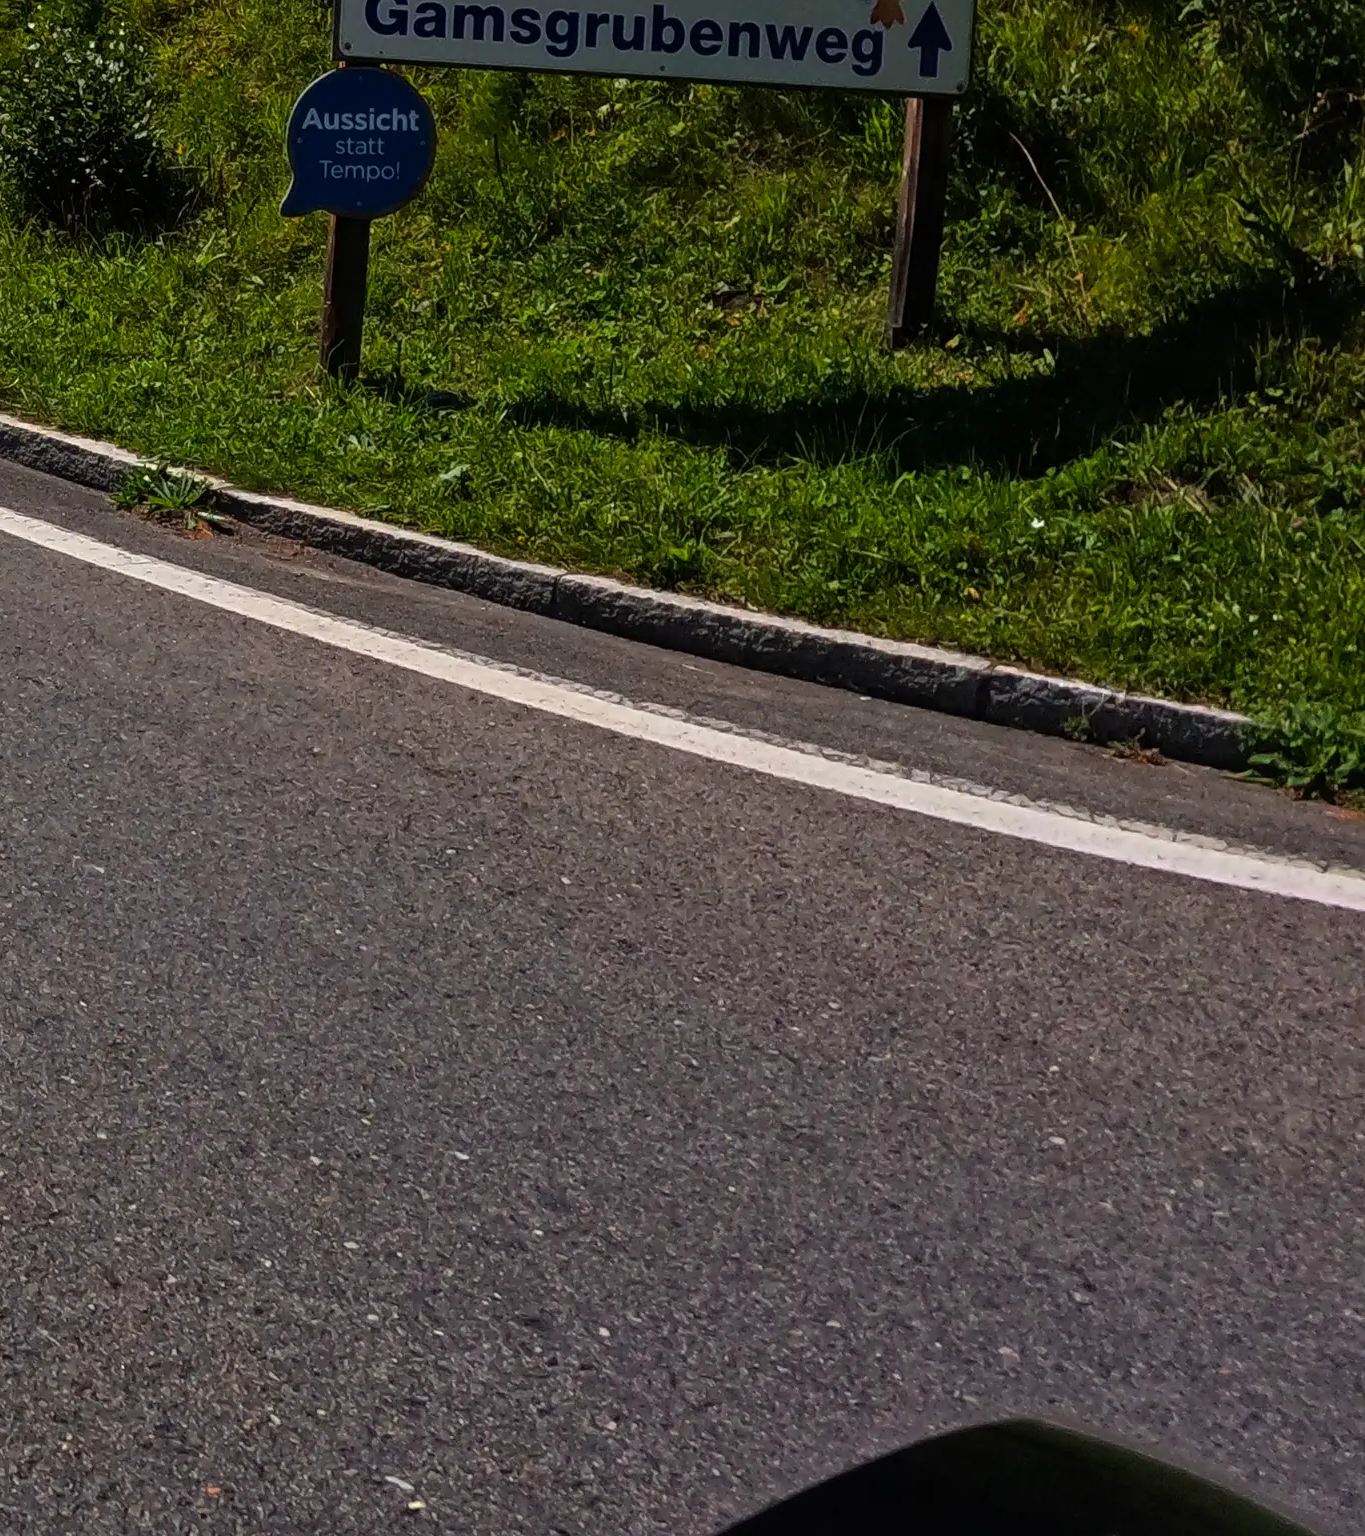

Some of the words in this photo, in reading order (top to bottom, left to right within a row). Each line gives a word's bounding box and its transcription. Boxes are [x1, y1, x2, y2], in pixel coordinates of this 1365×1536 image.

[301, 107, 420, 132] Aussicht
[335, 137, 386, 156] statt
[319, 160, 401, 183] Tempo!
